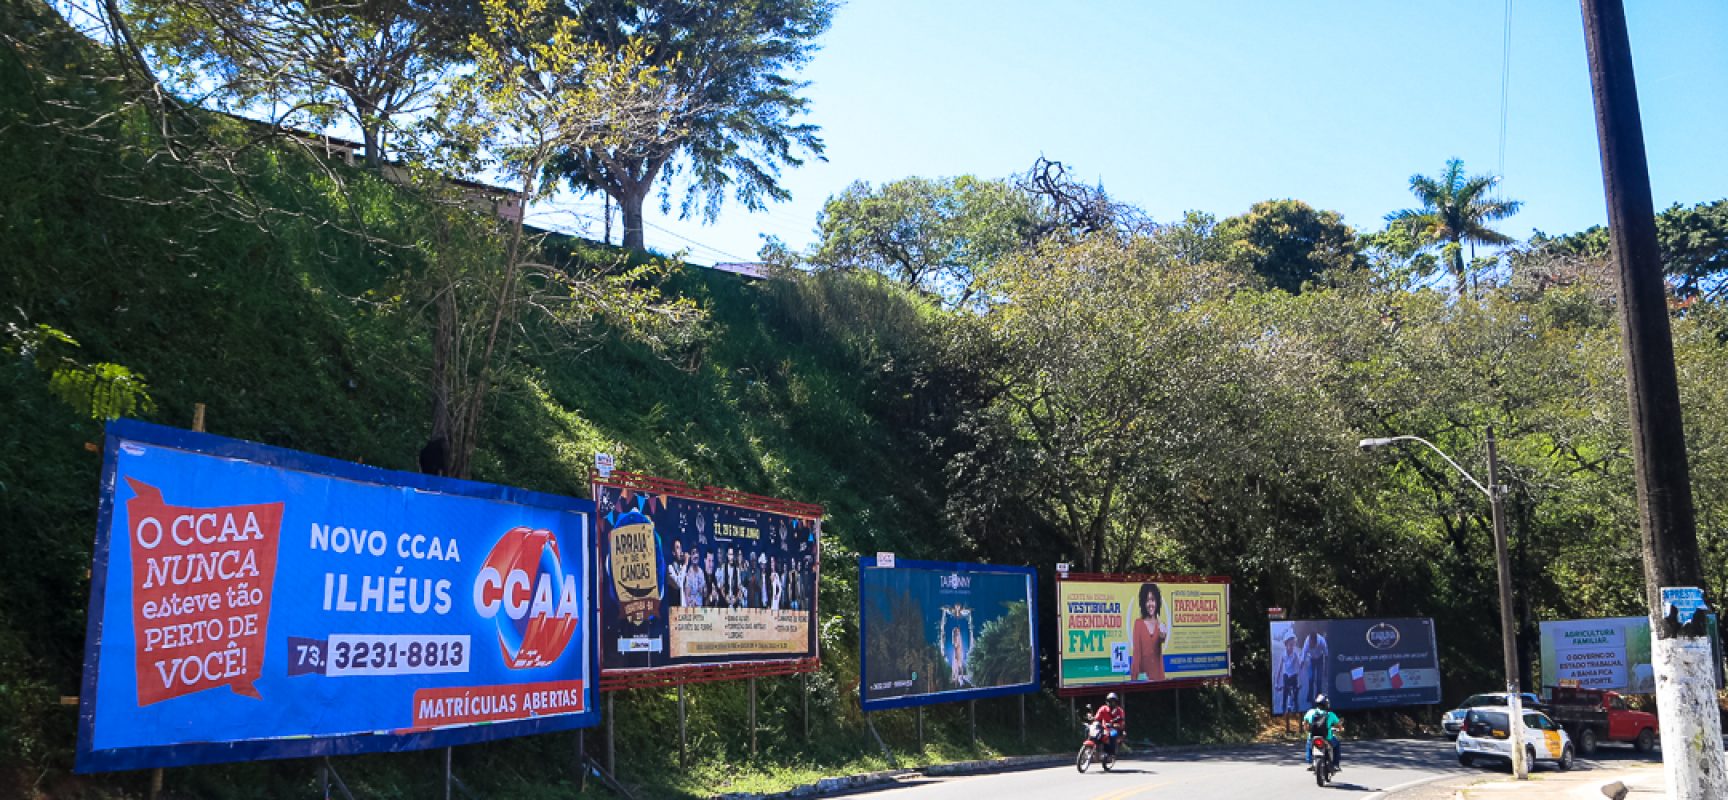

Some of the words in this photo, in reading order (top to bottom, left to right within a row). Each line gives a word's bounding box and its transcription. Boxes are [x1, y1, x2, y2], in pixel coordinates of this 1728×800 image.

[137, 517, 163, 549] O
[171, 511, 264, 546] CCAA
[310, 522, 387, 556] NOVO
[397, 532, 461, 563] CCAA
[143, 549, 260, 589] NUNCA
[142, 592, 221, 620] esteve
[226, 582, 263, 609] tão
[322, 565, 453, 615] ILHÉUS
[473, 567, 579, 621] CCAA
[1067, 601, 1121, 614] VESTIBULAR
[1068, 615, 1122, 629] AGENDADO
[143, 619, 223, 652] PERTO
[228, 613, 258, 638] DE
[1068, 630, 1105, 653] FMT
[1564, 628, 1615, 638] AGRICULTURA
[155, 641, 247, 690] VOCÊ!
[296, 645, 326, 668] 73.
[335, 640, 464, 668] 3231-8813
[1573, 652, 1604, 661] GOVERNO
[1578, 669, 1598, 678] BAHIA
[1599, 668, 1614, 676] FICA
[418, 693, 517, 720] MATRÍCULAS
[522, 689, 578, 713] ABERTAS
